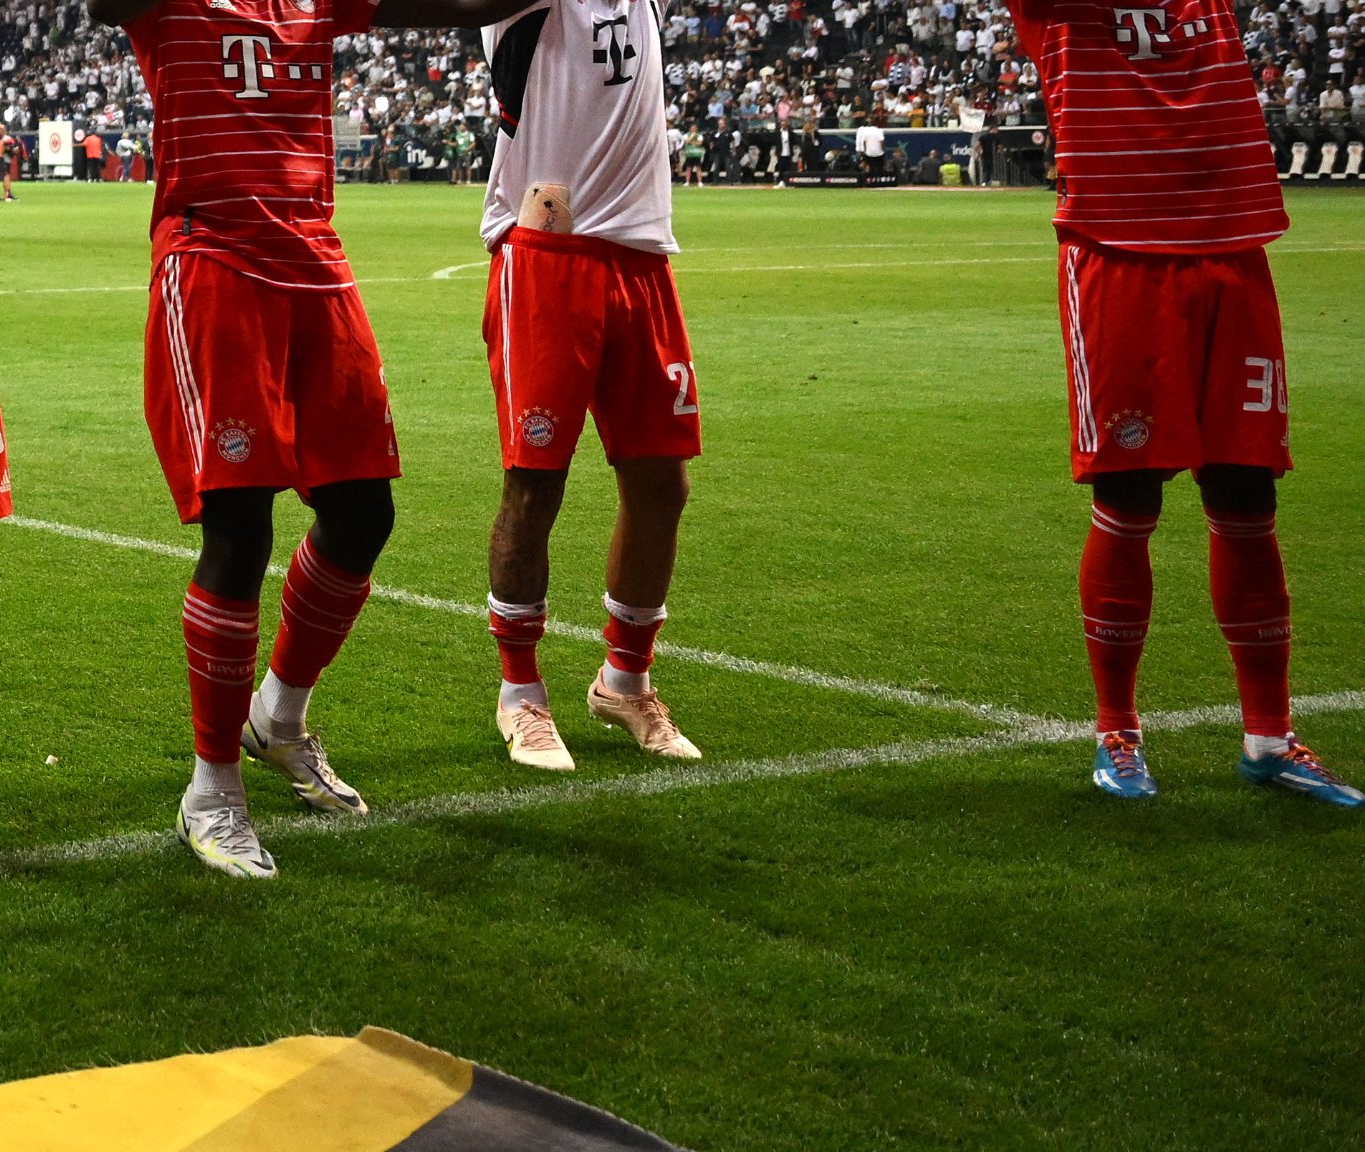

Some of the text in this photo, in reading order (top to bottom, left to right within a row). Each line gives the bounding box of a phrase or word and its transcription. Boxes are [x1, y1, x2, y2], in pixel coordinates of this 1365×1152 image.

[210, 2, 237, 12] adidas
[1113, 8, 1170, 61] T
[222, 34, 275, 100] T
[592, 14, 637, 87] T
[665, 361, 698, 416] 2
